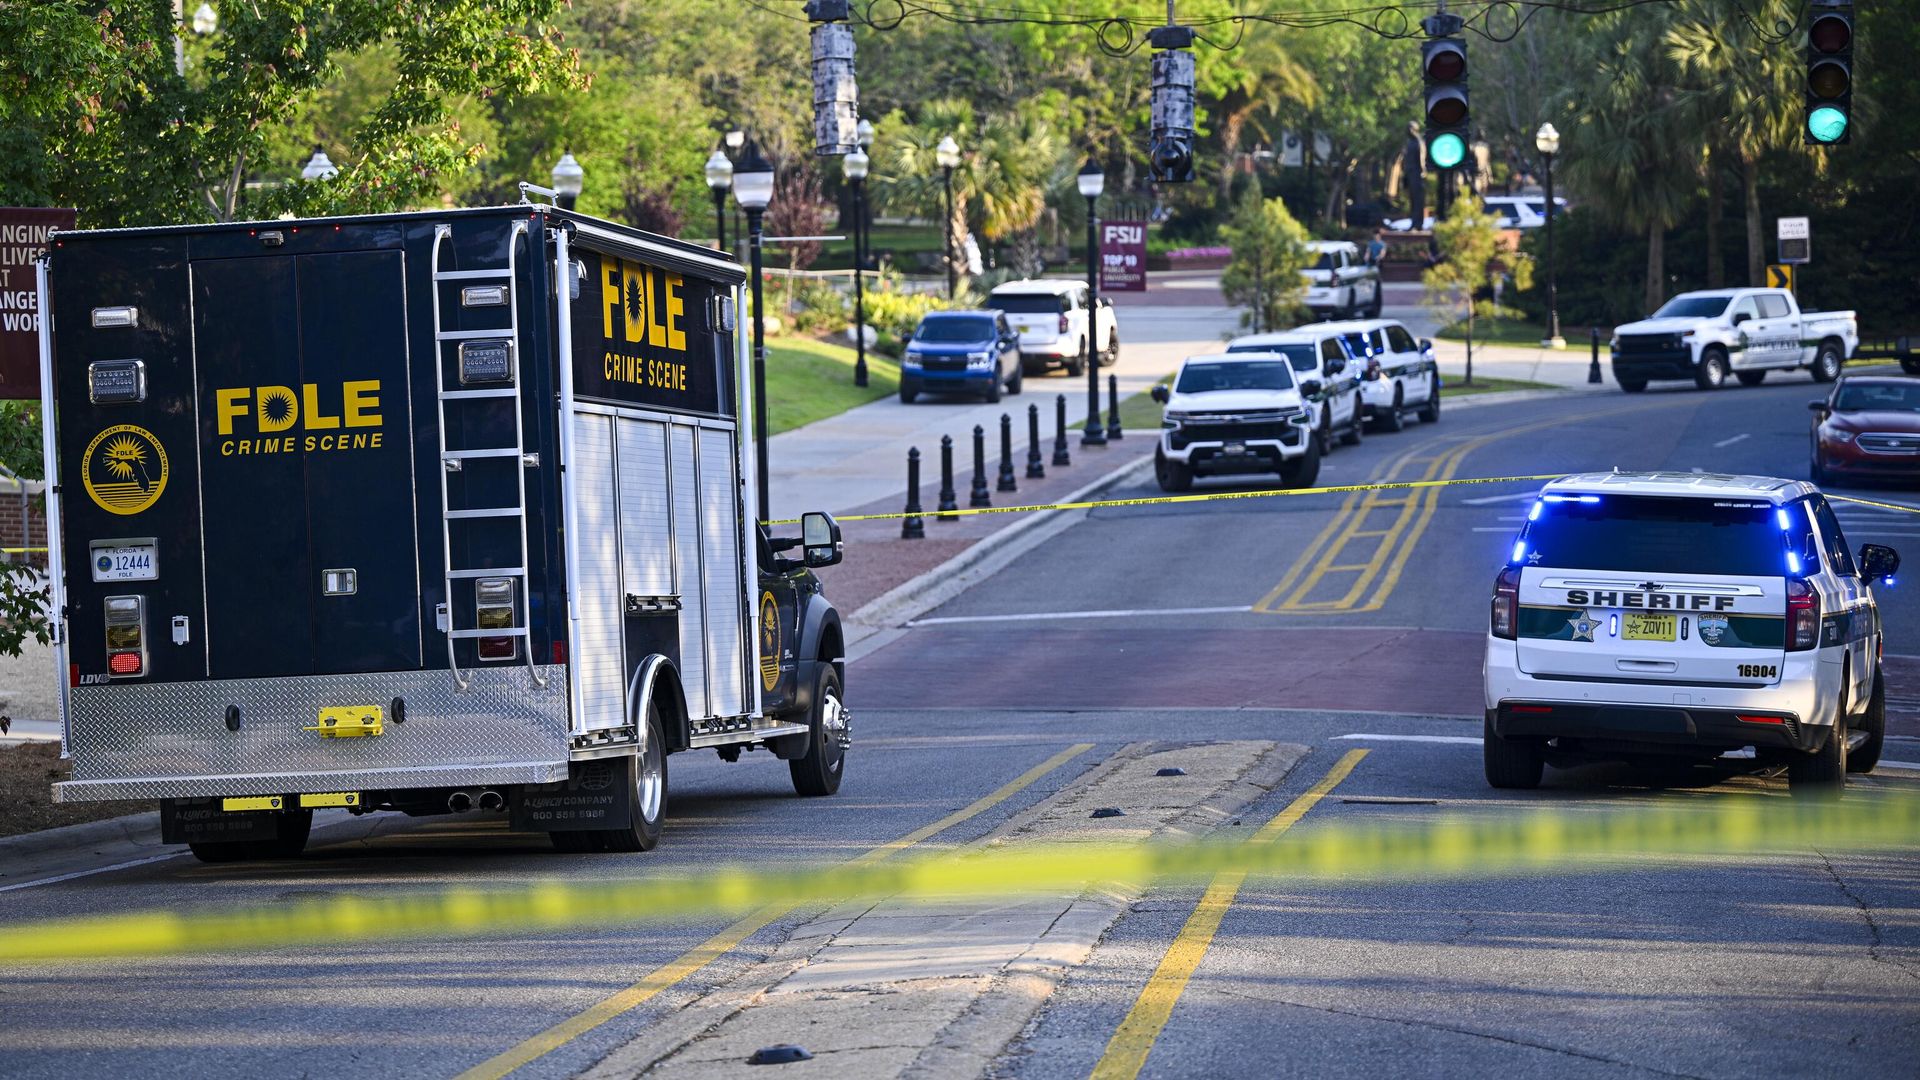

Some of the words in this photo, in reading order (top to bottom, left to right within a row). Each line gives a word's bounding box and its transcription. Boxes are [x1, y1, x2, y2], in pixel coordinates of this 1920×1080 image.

[1104, 226, 1142, 244] FSU
[1102, 254, 1124, 266] TOP
[1125, 254, 1138, 266] 10
[601, 258, 686, 351] FDLE
[604, 352, 642, 384] CRIME
[648, 360, 686, 390] SCENE
[216, 380, 383, 435] FDLE
[88, 426, 120, 452] DEPARTMENT
[134, 428, 147, 436] LAW
[148, 436, 167, 477] ENFORCEMENT
[221, 437, 296, 456] CRIME
[304, 432, 383, 452] SCENE
[116, 554, 150, 570] 12444
[1567, 590, 1734, 610] SHERIFF
[80, 674, 101, 684] LDV
[1736, 664, 1776, 678] 16904
[564, 796, 614, 804] COMPANY
